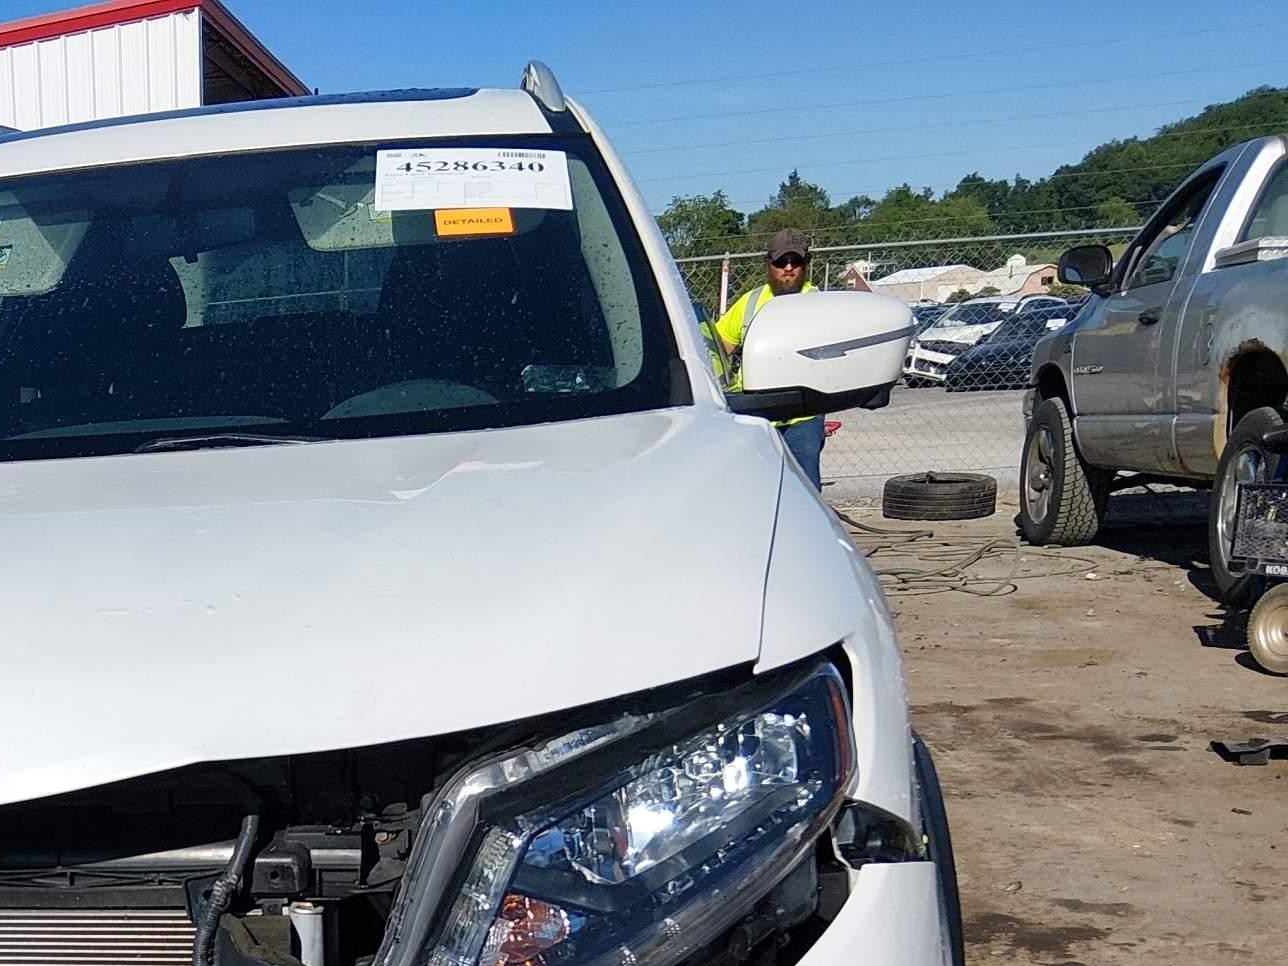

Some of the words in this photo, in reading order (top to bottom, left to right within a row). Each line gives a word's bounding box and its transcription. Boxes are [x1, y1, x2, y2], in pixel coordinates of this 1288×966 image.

[397, 161, 545, 172] 45286340
[443, 217, 503, 225] DETAILED
[1266, 565, 1288, 575] KOB
